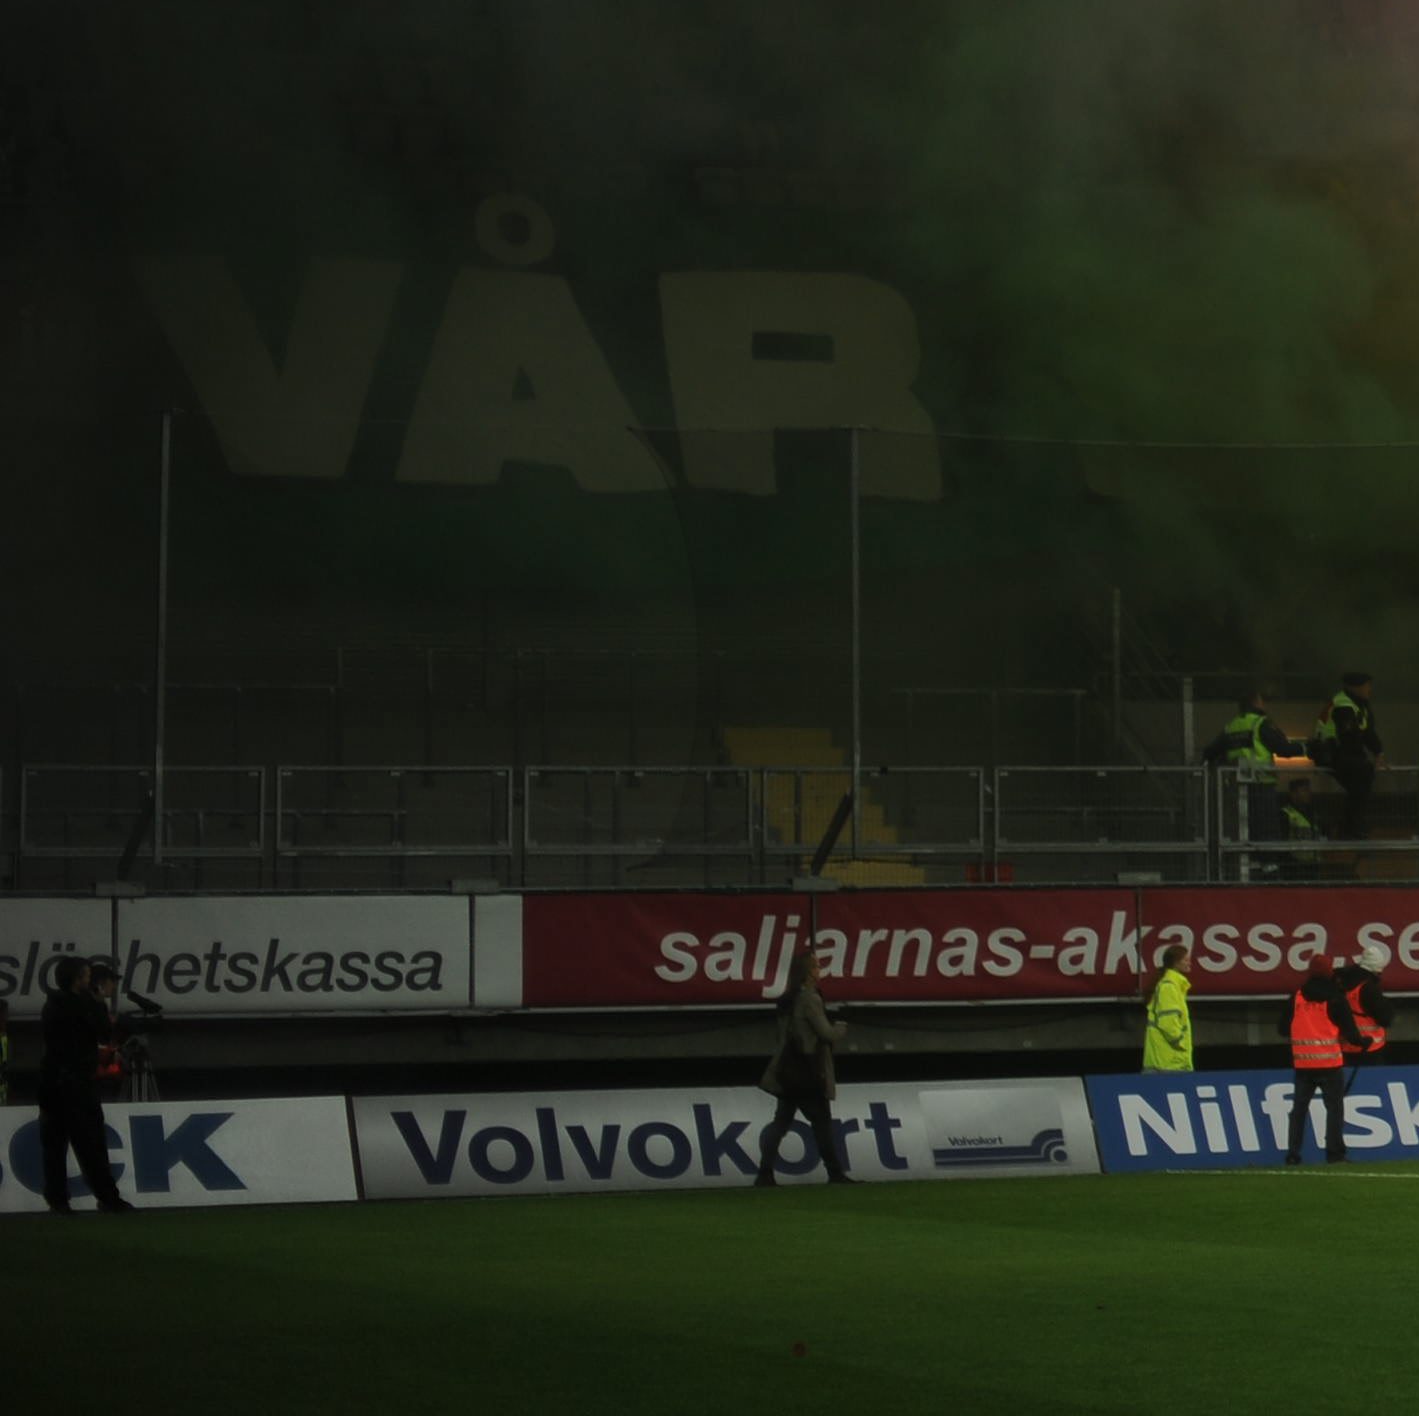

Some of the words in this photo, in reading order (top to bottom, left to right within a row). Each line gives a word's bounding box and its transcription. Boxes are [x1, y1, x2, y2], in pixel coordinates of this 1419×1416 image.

[131, 191, 943, 503] VÅR
[0, 1111, 249, 1198] CK
[391, 1102, 909, 1186] Volvokort
[948, 1134, 1003, 1147] Volvokort
